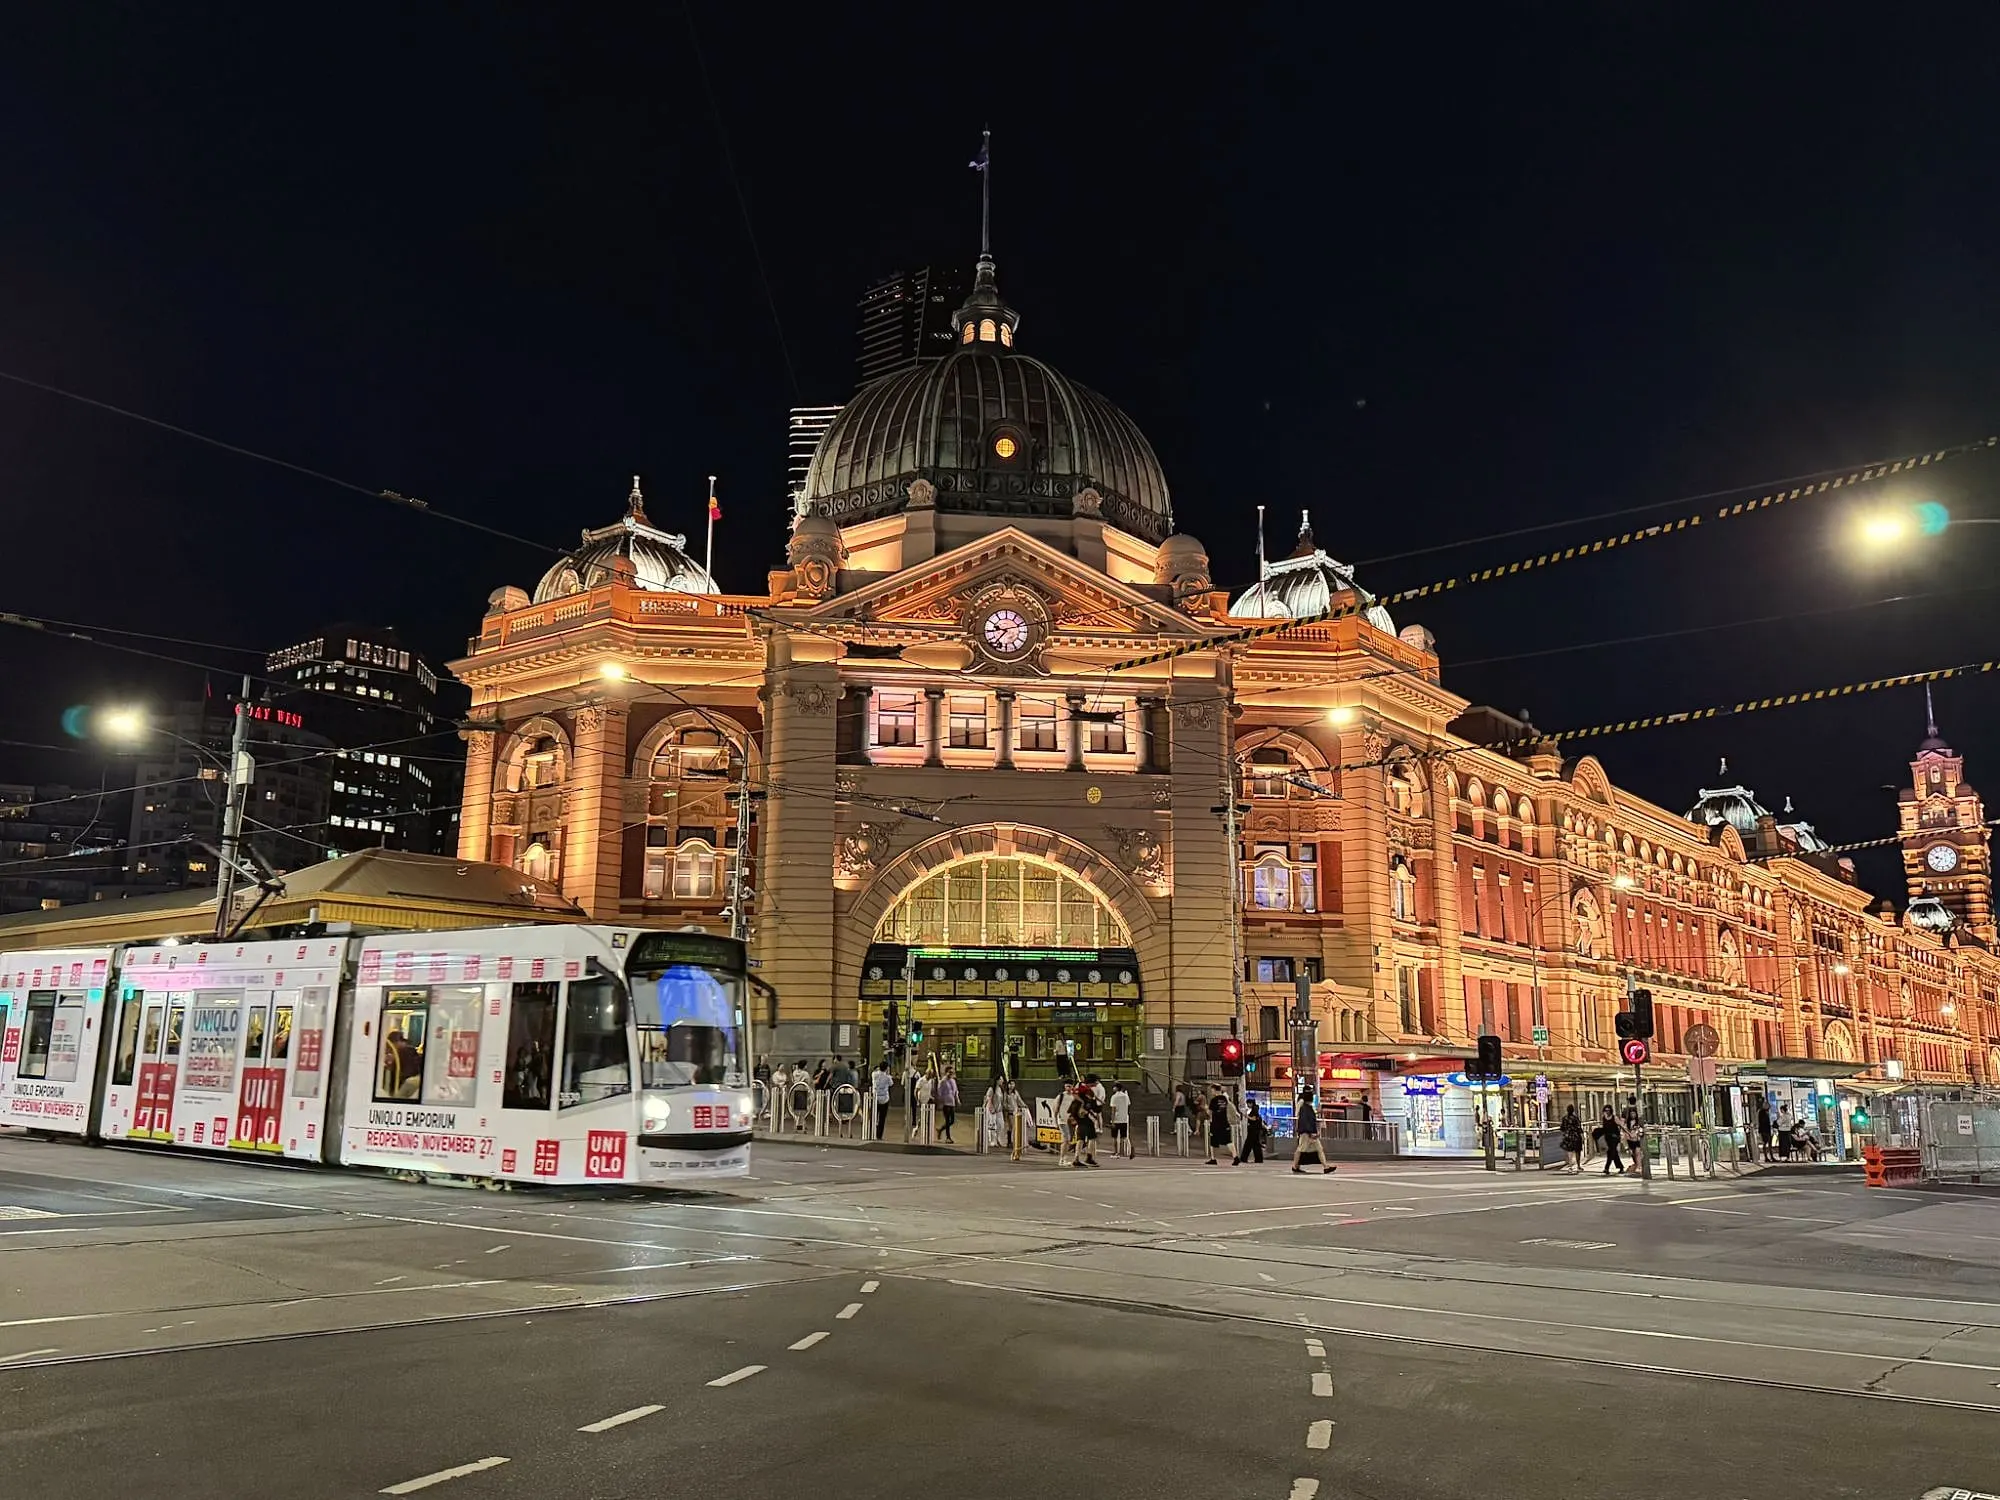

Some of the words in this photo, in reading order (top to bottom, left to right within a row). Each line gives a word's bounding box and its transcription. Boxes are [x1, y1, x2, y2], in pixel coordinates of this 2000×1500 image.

[277, 710, 302, 728] WEST
[194, 1010, 238, 1036] UNIQLO
[453, 1036, 475, 1052] UNI
[451, 1056, 474, 1076] QLO
[14, 1083, 34, 1096] UNIQLO
[35, 1085, 65, 1098] EMPORIUM
[244, 1078, 277, 1109] UNI
[12, 1099, 42, 1113] REOPENING
[44, 1102, 74, 1116] NOVEMBER
[369, 1109, 402, 1127] UNIQLO
[406, 1112, 456, 1129] EMPORIUM
[366, 1130, 419, 1149] REOPENING
[422, 1135, 476, 1154] NOVEMBER
[590, 1136, 622, 1154] UNI
[589, 1155, 621, 1175] QLO
